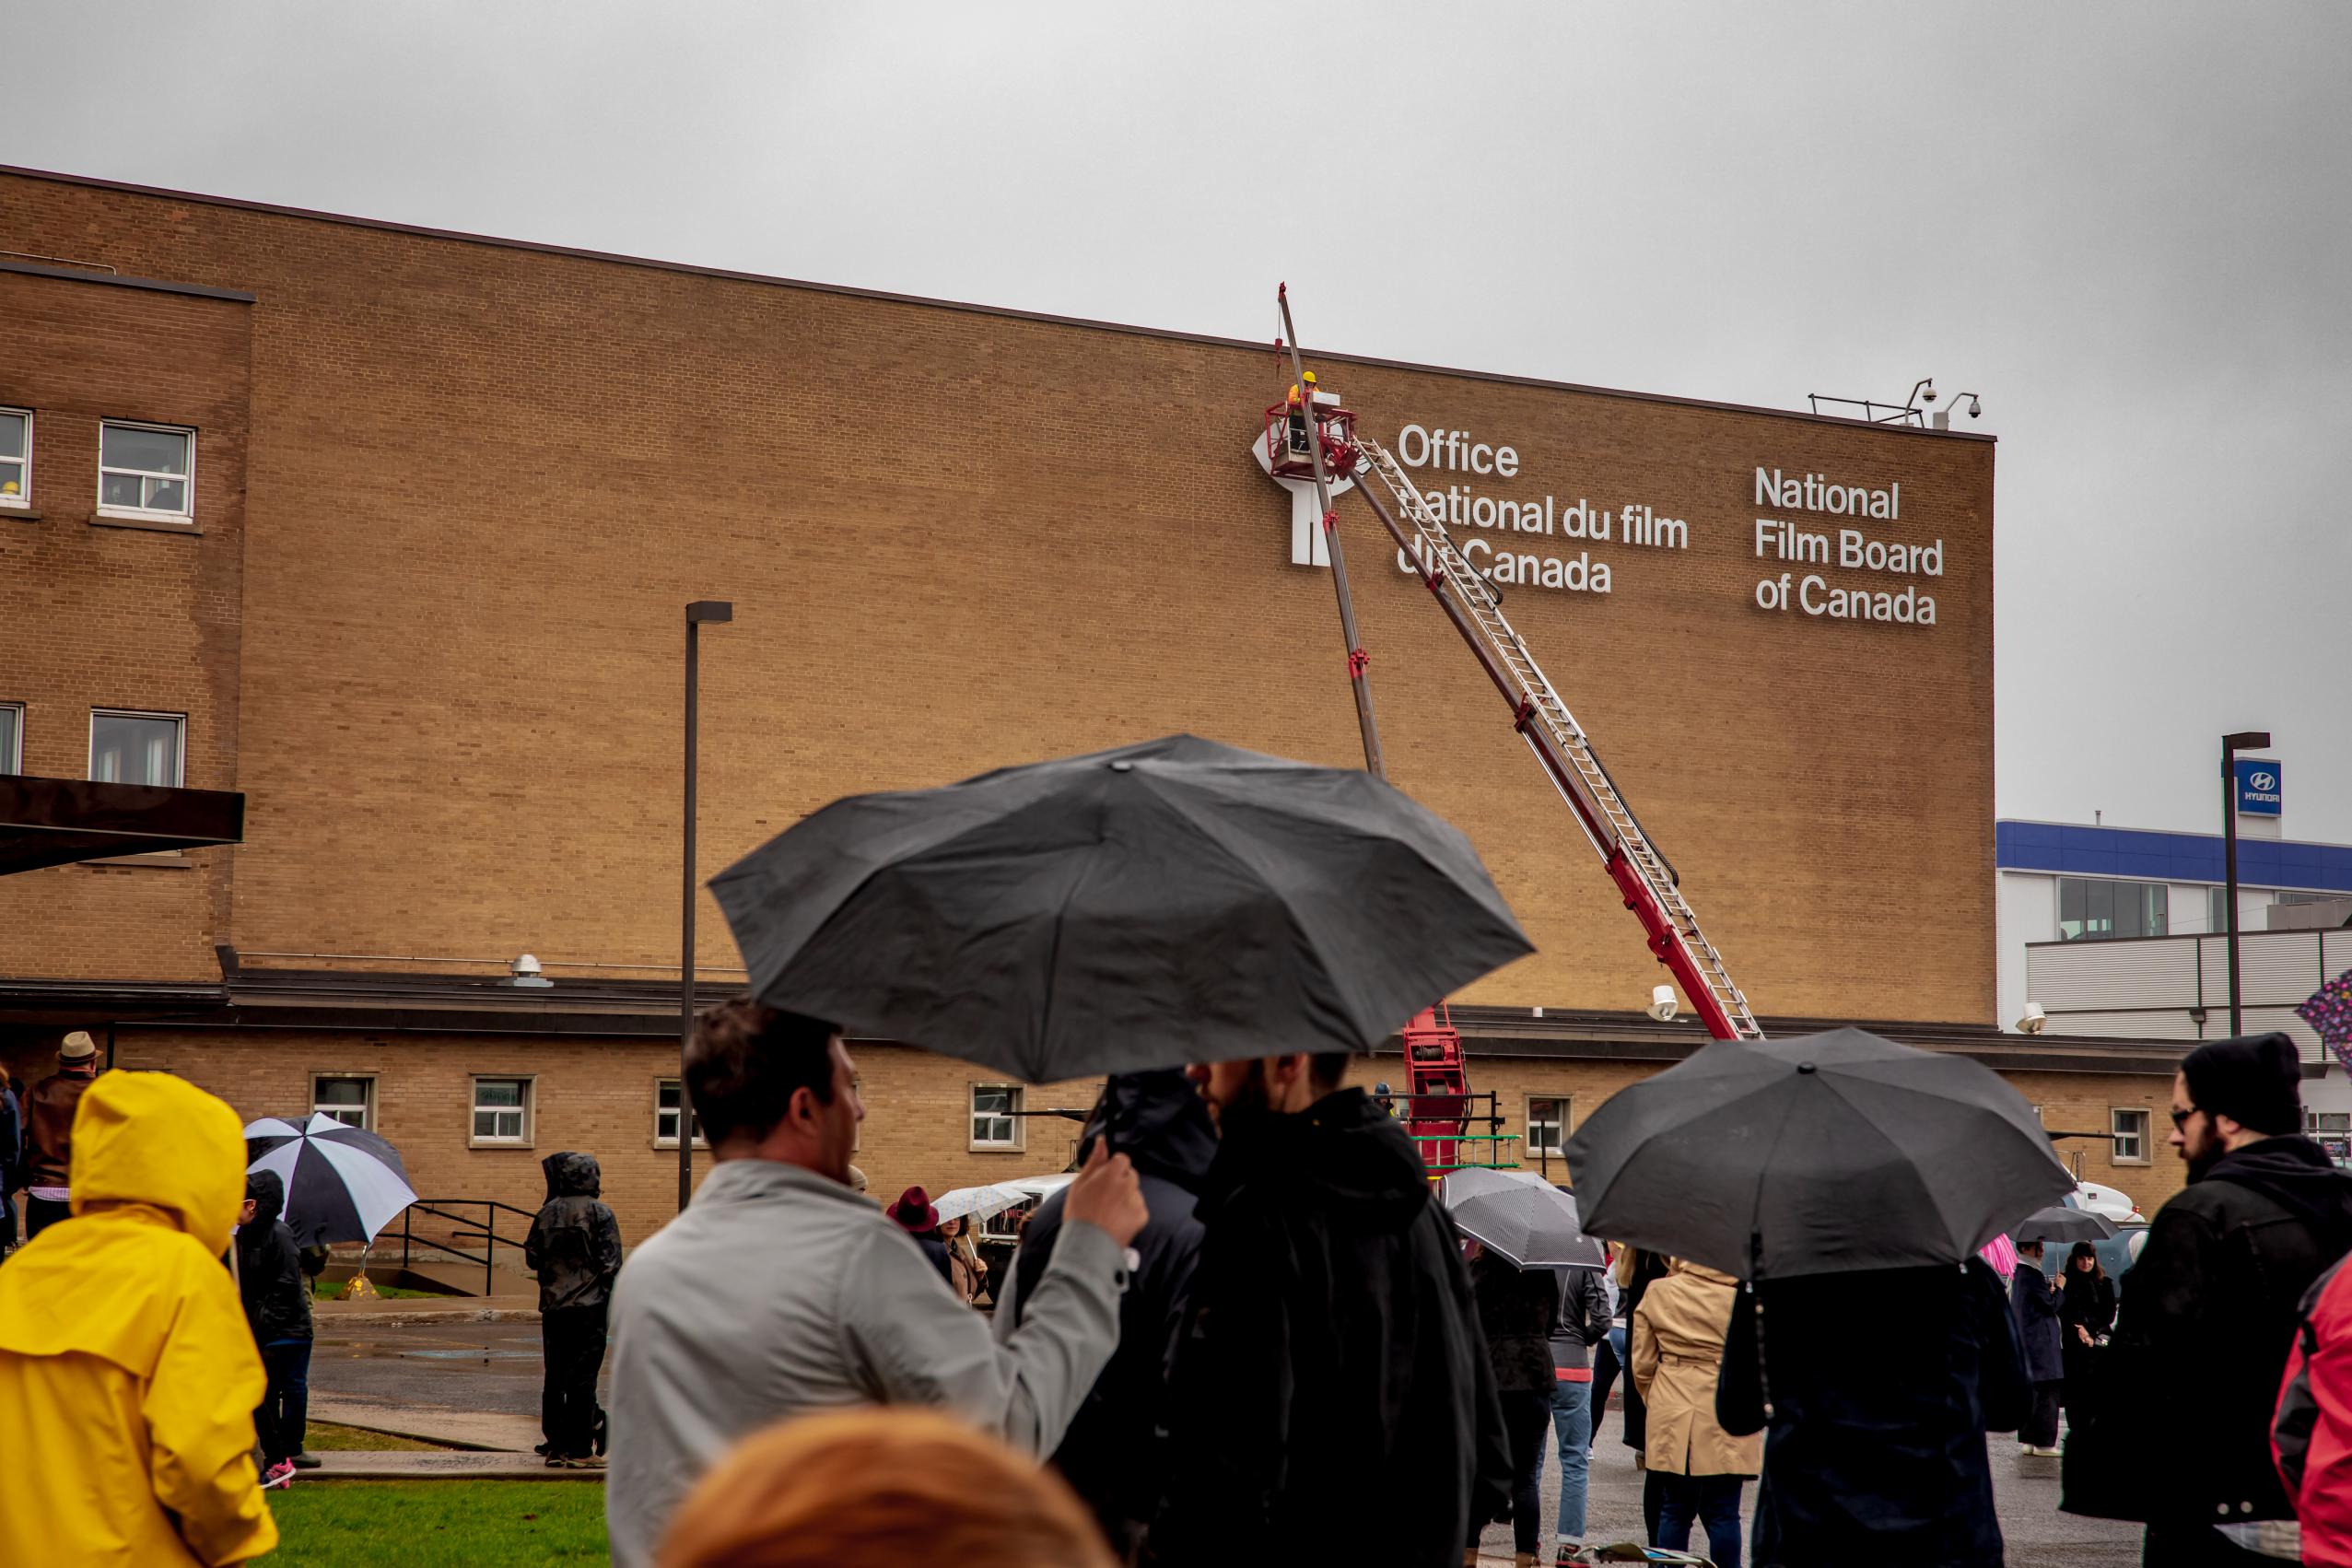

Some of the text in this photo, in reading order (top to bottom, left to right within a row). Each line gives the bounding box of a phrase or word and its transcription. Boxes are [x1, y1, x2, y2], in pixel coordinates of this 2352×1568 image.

[1398, 424, 1519, 477] Office
[1399, 486, 1688, 549] national du film
[1755, 466, 1899, 520] National
[1461, 538, 1611, 593] Canada
[1755, 518, 1943, 576] Film Board
[1755, 572, 1937, 625] of Canada
[2244, 792, 2280, 802] HYUNDAI
